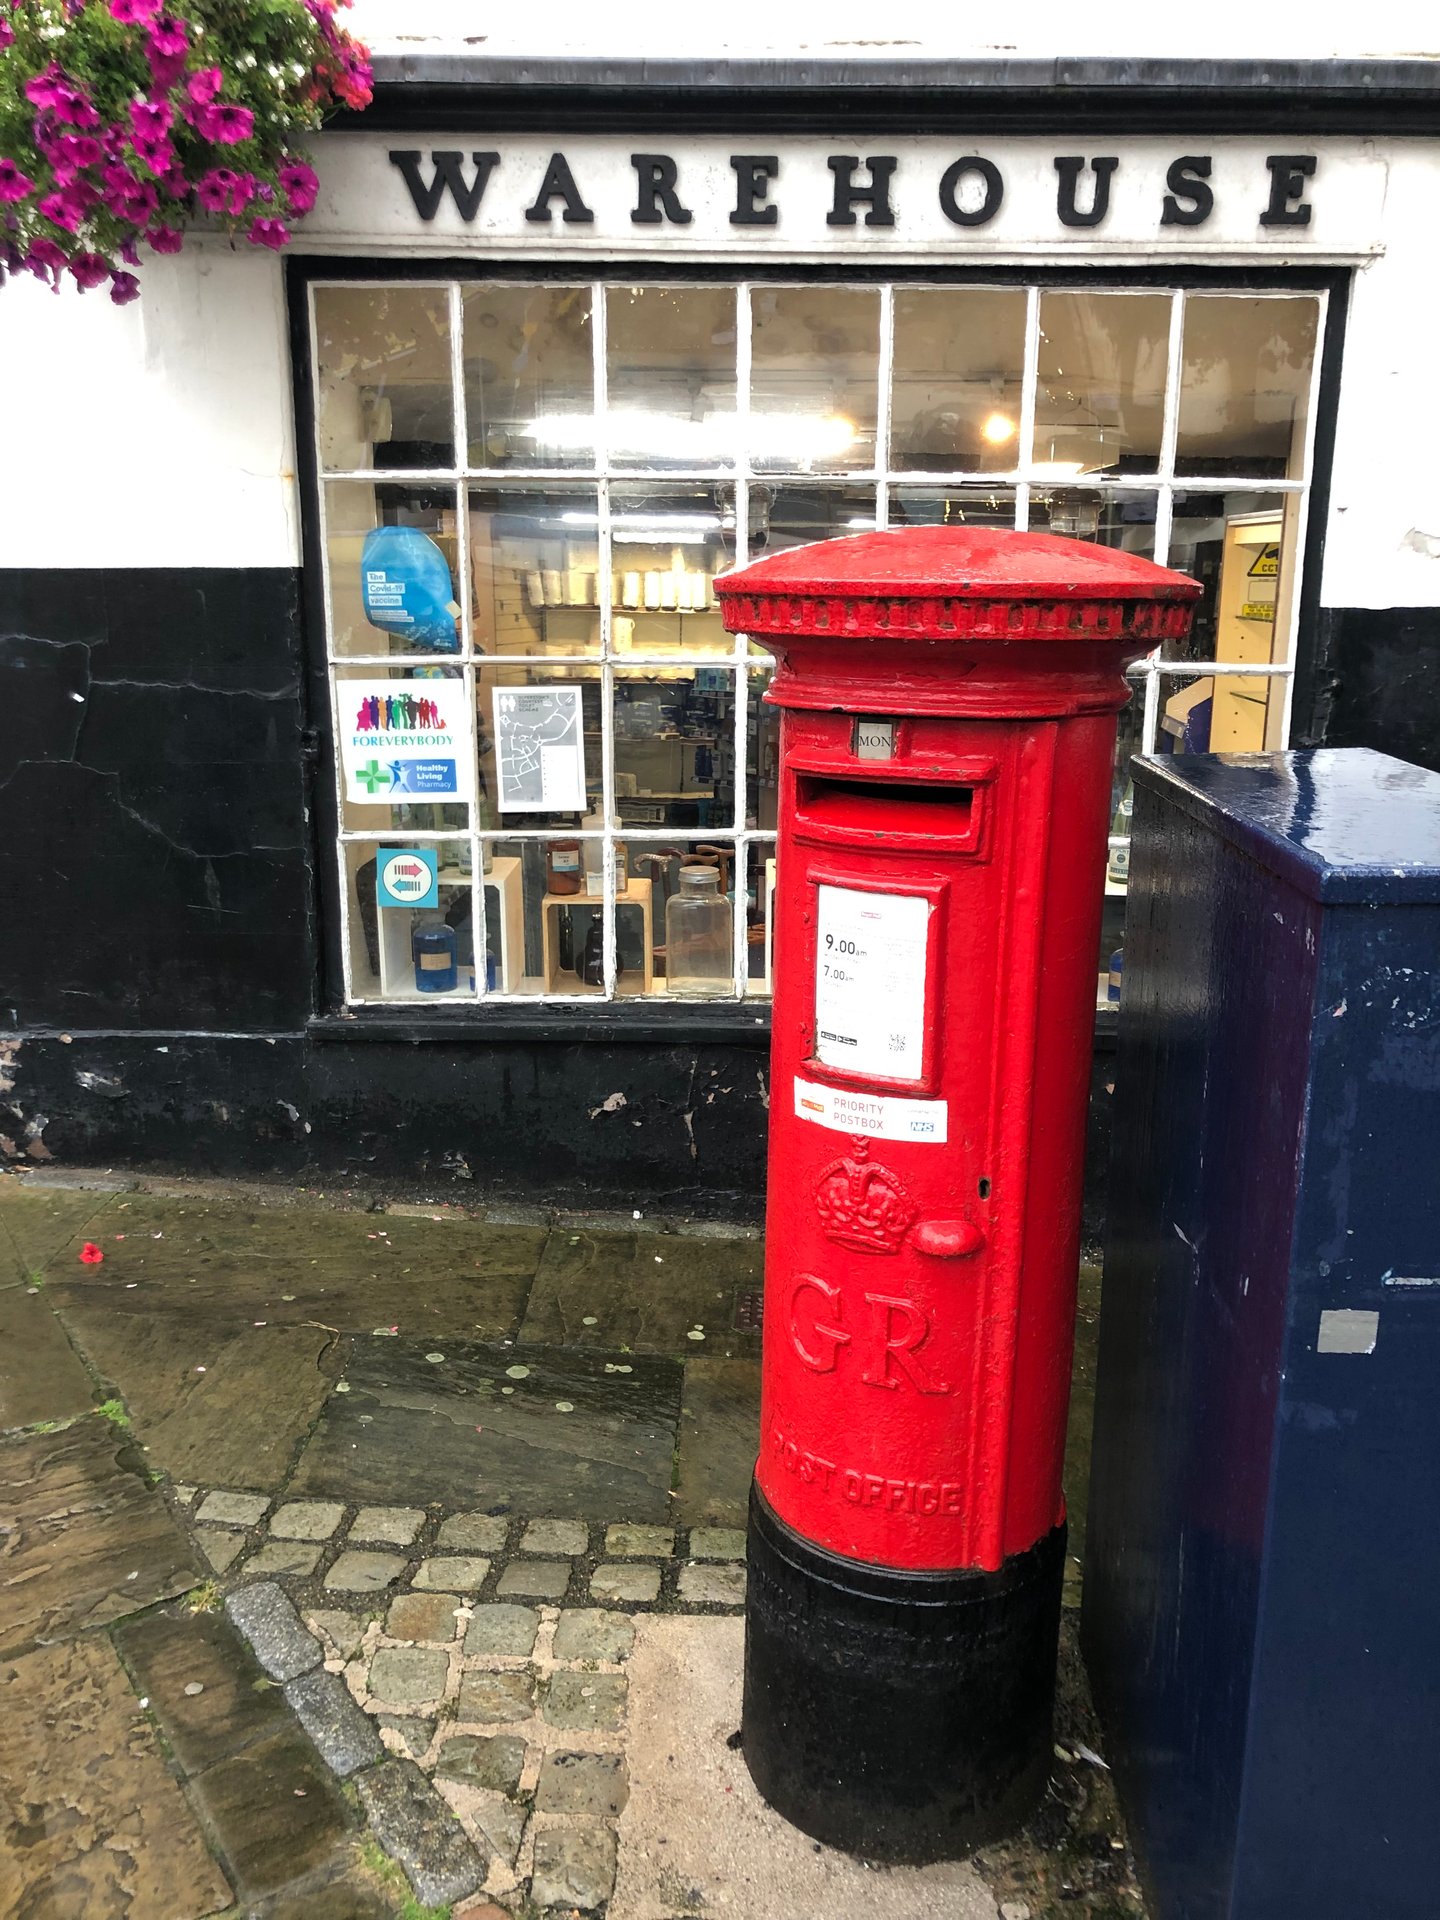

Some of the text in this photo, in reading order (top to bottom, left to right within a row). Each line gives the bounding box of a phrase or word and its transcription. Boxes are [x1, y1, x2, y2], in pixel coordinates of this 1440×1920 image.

[389, 151, 1318, 226] WAREHOUSE
[1262, 564, 1278, 573] CCT
[369, 584, 403, 592] Covid-19
[353, 735, 453, 746] FOREVERYBODY
[859, 735, 892, 747] MON
[416, 764, 448, 773] Healthy
[416, 773, 443, 781] Living
[417, 781, 452, 789] Pharmacy
[834, 1097, 884, 1115] PRIORITY
[834, 1112, 884, 1130] POSTBOX
[911, 1121, 934, 1132] NHS
[774, 1429, 961, 1516] POST OFFICE
